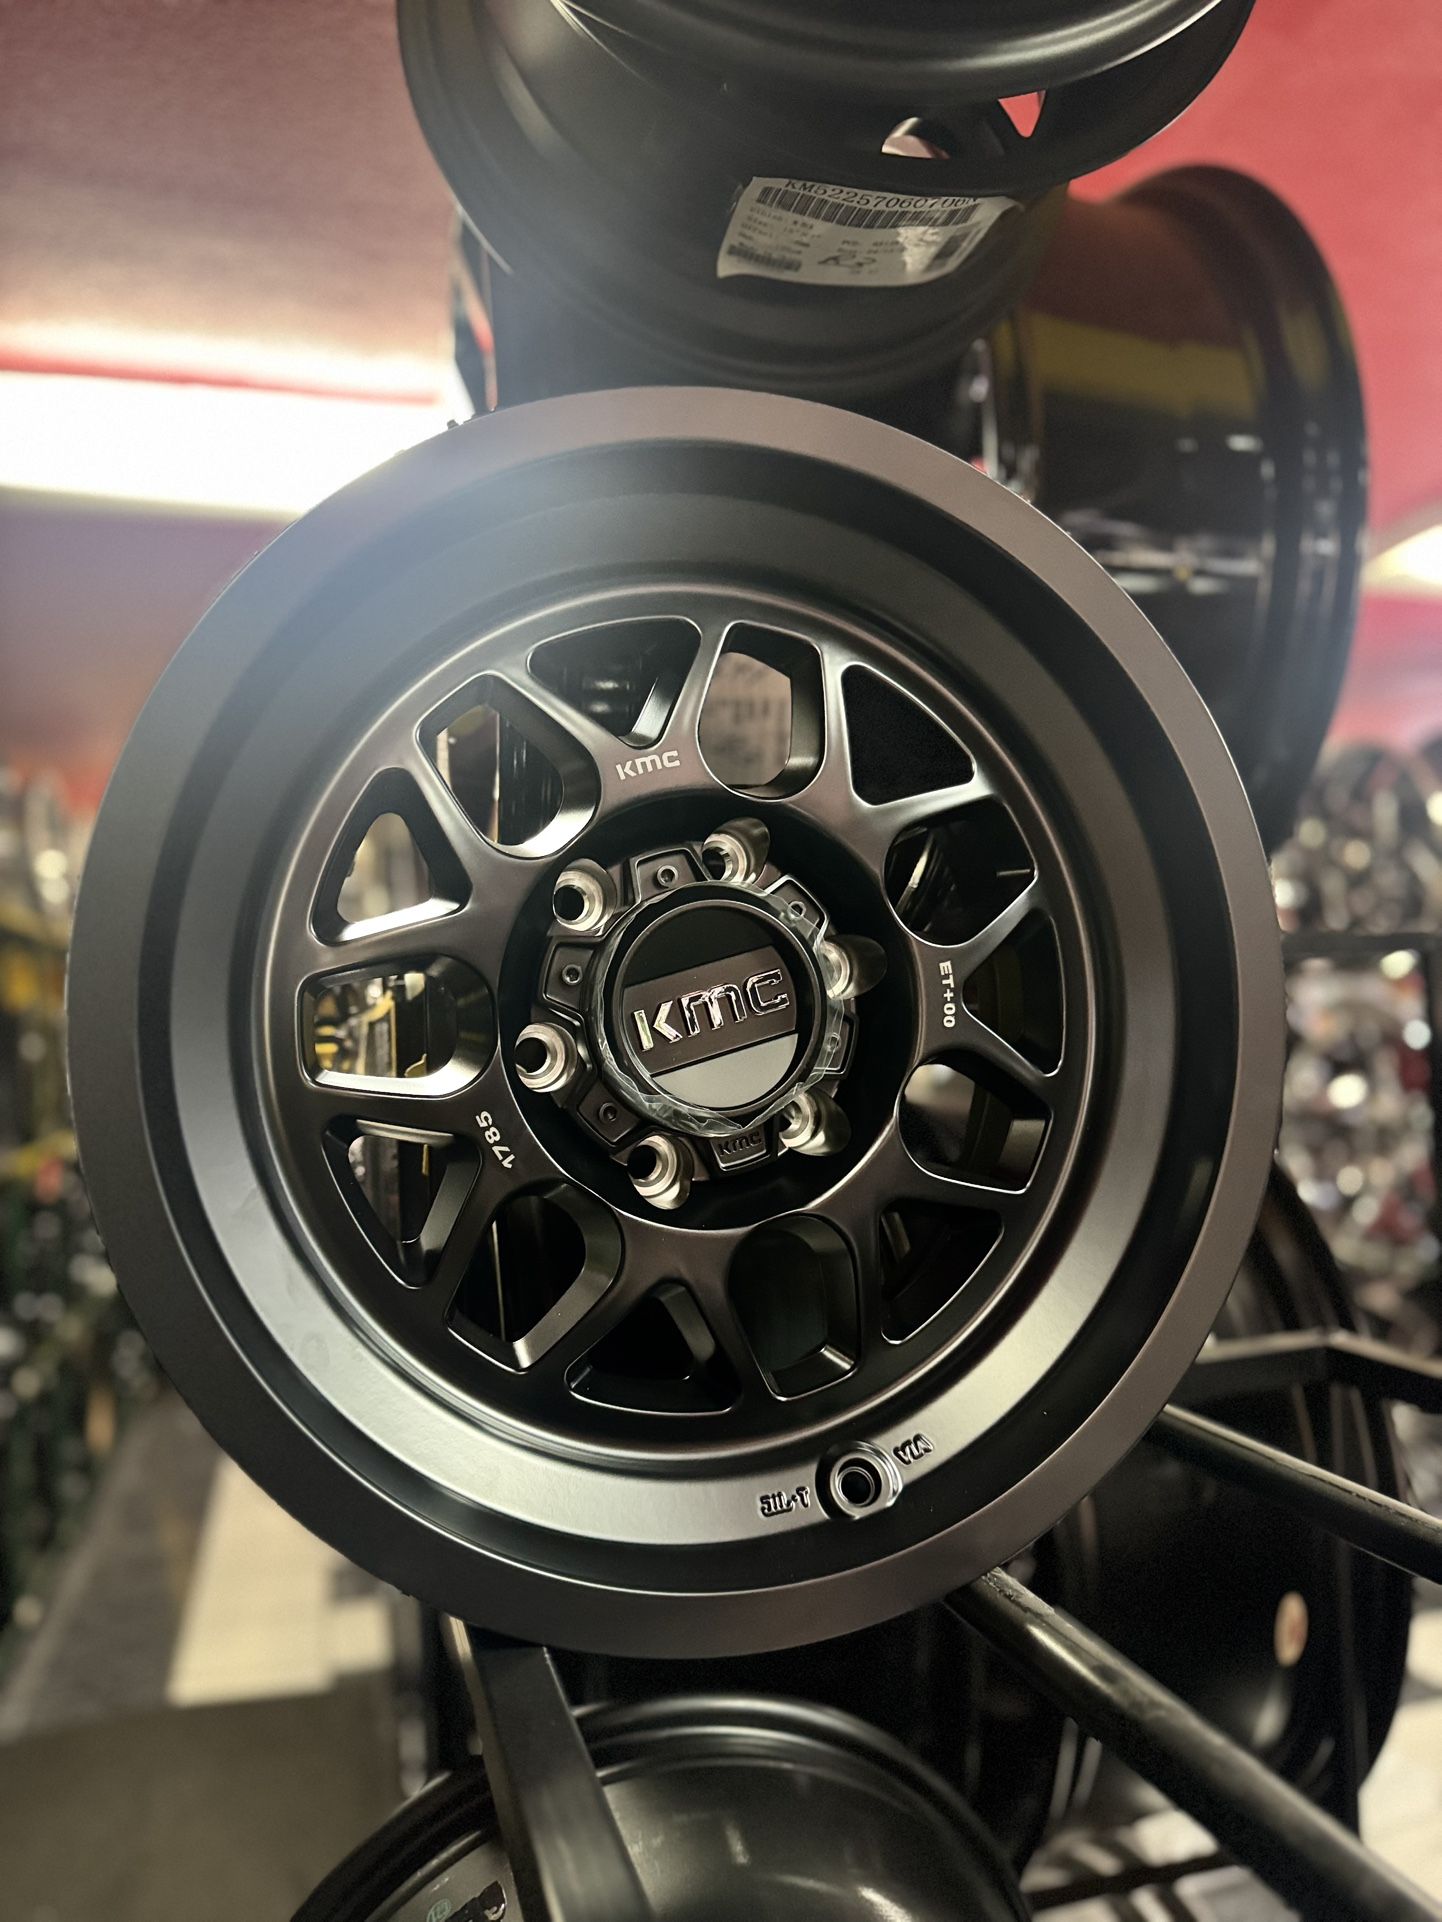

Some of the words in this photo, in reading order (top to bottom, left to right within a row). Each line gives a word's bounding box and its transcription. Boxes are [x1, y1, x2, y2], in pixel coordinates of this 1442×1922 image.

[615, 750, 681, 780] KMC
[633, 968, 790, 1052] KMC
[939, 960, 956, 1028] ET+00
[475, 1110, 516, 1169] 1785
